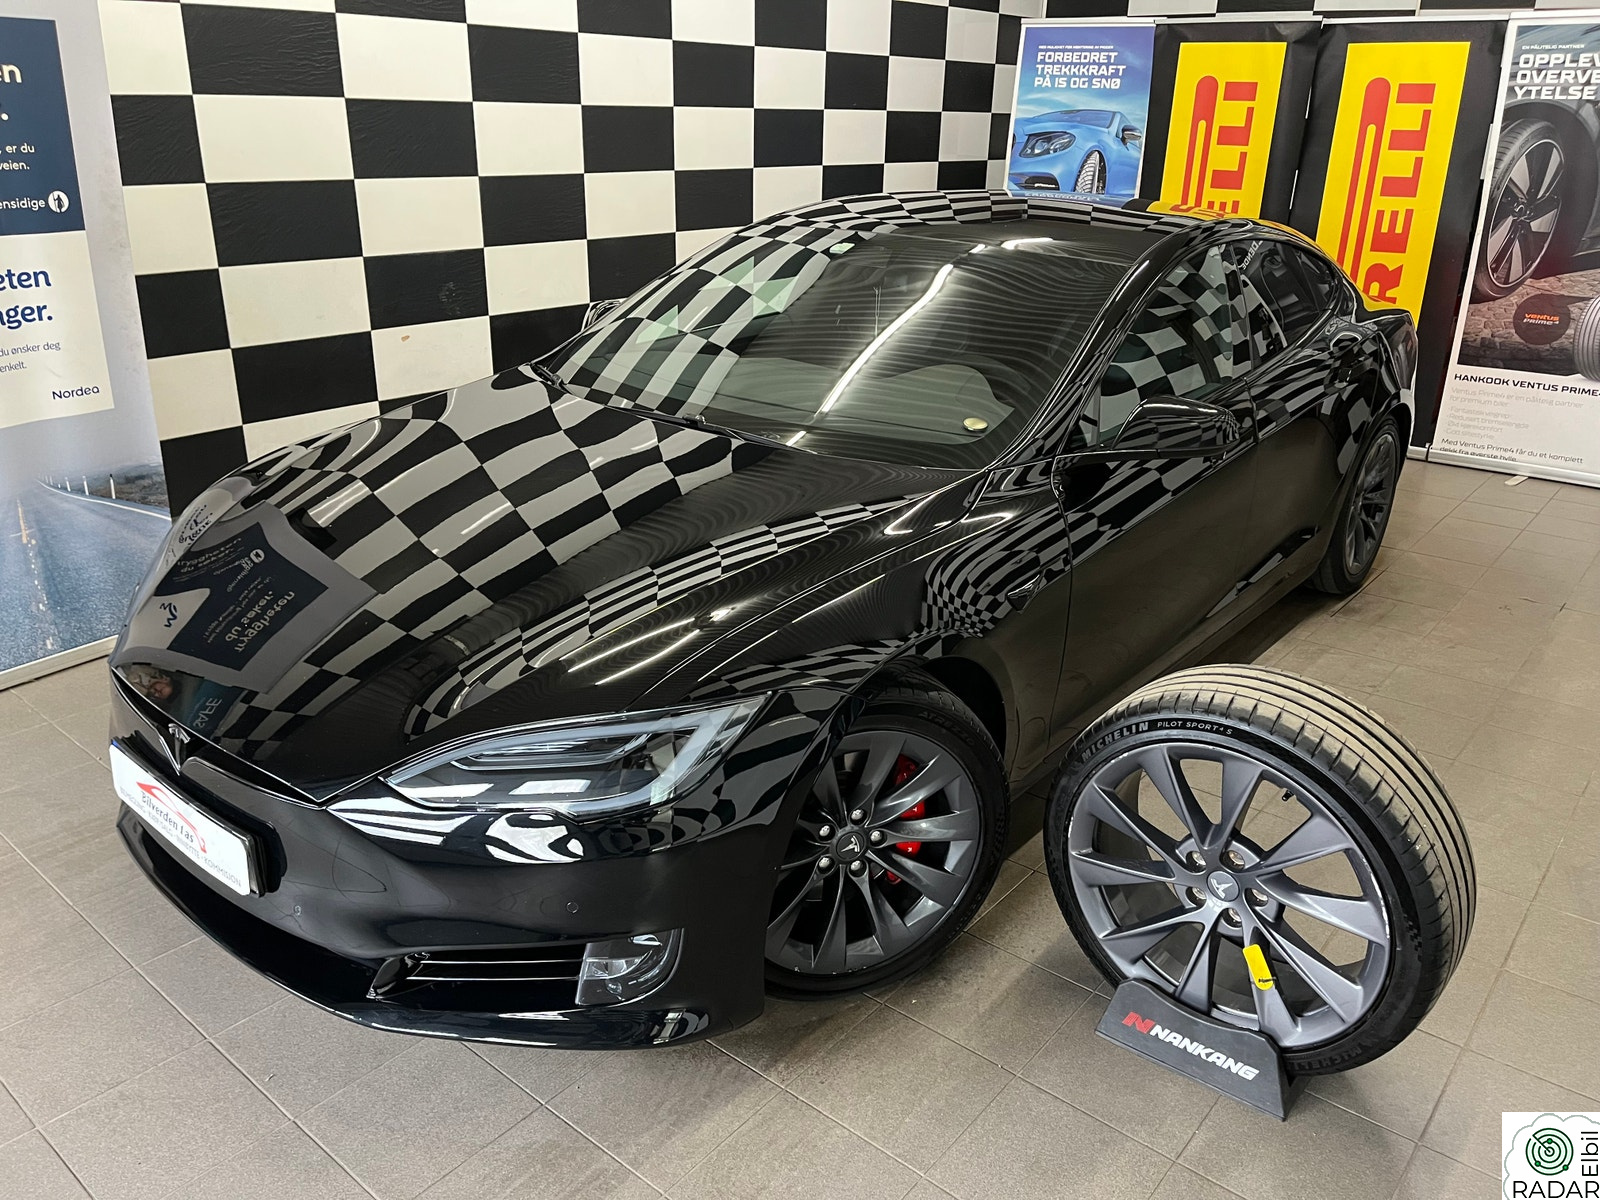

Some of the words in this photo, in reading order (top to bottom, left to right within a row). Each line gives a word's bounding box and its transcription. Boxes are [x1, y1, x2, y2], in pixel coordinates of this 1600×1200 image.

[1037, 51, 1119, 63] FORBEDRET
[0, 64, 22, 84] n
[1036, 64, 1127, 77] TREKKKRAFT
[1034, 74, 1052, 88] PÅ
[1054, 77, 1068, 88] IS
[1070, 77, 1089, 89] OG
[1091, 78, 1121, 90] SNØ
[1513, 85, 1597, 100] YTELSE
[5, 145, 17, 153] er
[20, 142, 35, 153] du
[11, 344, 41, 355] ønsker
[42, 341, 61, 352] deg
[52, 385, 100, 400] Nordea
[1454, 373, 1510, 387] HANKOOK
[1512, 379, 1559, 392] VENTUS
[1561, 385, 1600, 398] PRIME
[1441, 438, 1458, 446] Med
[1460, 441, 1486, 450] Ventus
[1548, 453, 1584, 464] komplett
[1080, 721, 1149, 762] MICHELIN
[1157, 720, 1183, 729] PILOT
[1148, 1023, 1260, 1082] NANKANG
